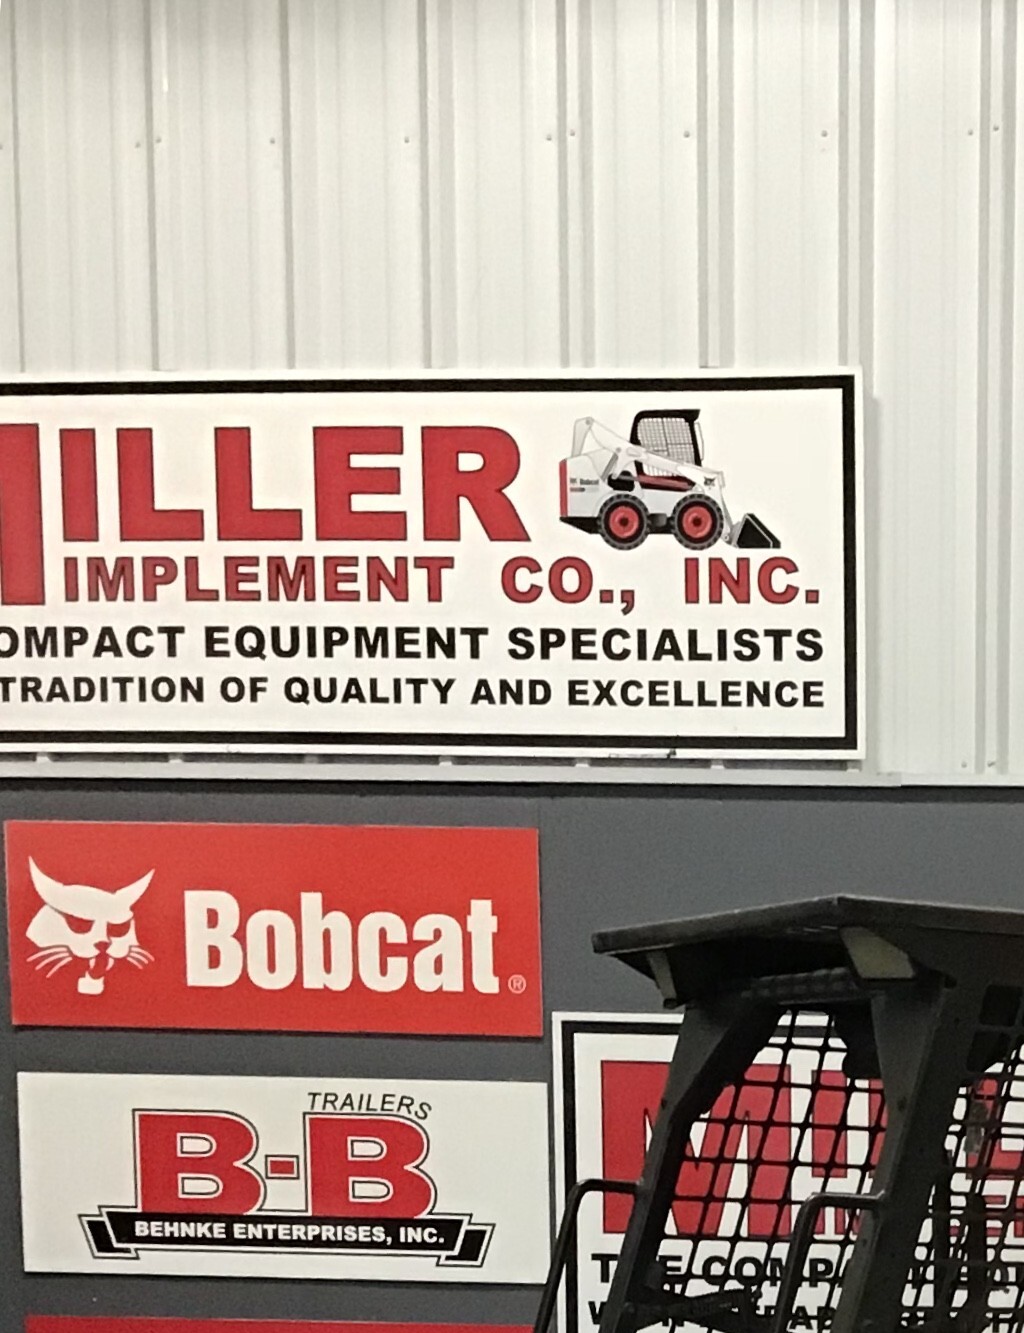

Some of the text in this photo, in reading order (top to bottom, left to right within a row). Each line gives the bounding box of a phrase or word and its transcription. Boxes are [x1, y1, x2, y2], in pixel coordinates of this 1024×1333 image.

[0, 424, 532, 606] ILLER
[64, 556, 820, 617] IMPLEMENT CO., INC.
[205, 626, 490, 662] EQUIPMENT
[508, 628, 825, 664] SPECIALISTS
[0, 676, 825, 709] TRADITION OF QUALITY AND EXCELLENCE
[185, 890, 500, 995] Bobcat
[307, 1092, 433, 1122] TRAILERS
[131, 1108, 437, 1218] B-B
[134, 1220, 446, 1246] BEHNKE ENTERPRISES, INC.
